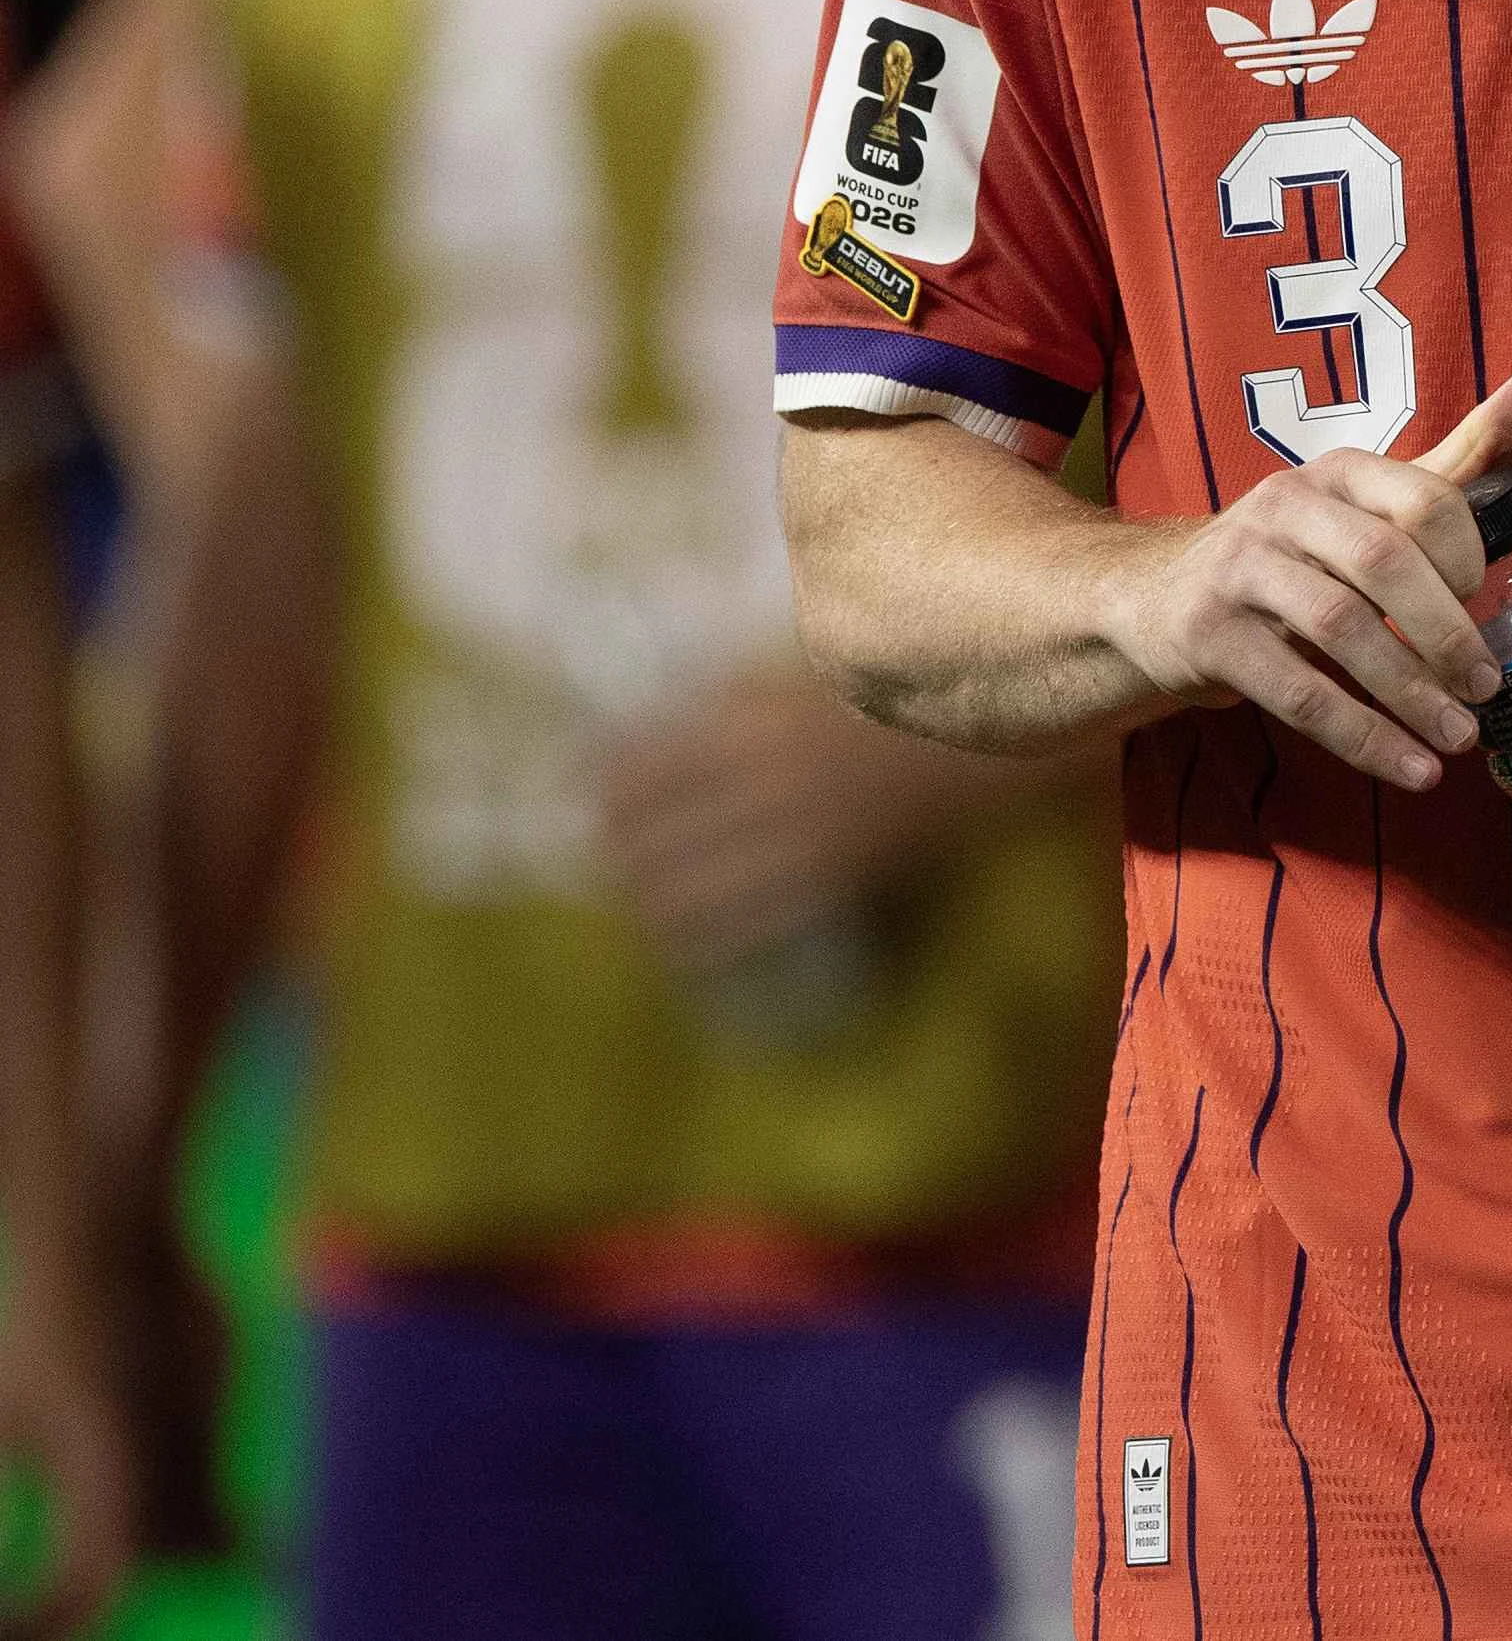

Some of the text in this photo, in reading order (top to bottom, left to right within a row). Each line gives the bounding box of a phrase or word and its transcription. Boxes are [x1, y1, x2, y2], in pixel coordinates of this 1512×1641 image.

[862, 142, 900, 171] FIFA
[836, 173, 919, 210] WORLD CUP
[832, 192, 917, 235] 026
[838, 238, 911, 295] DEBUT
[1217, 116, 1417, 468] 3
